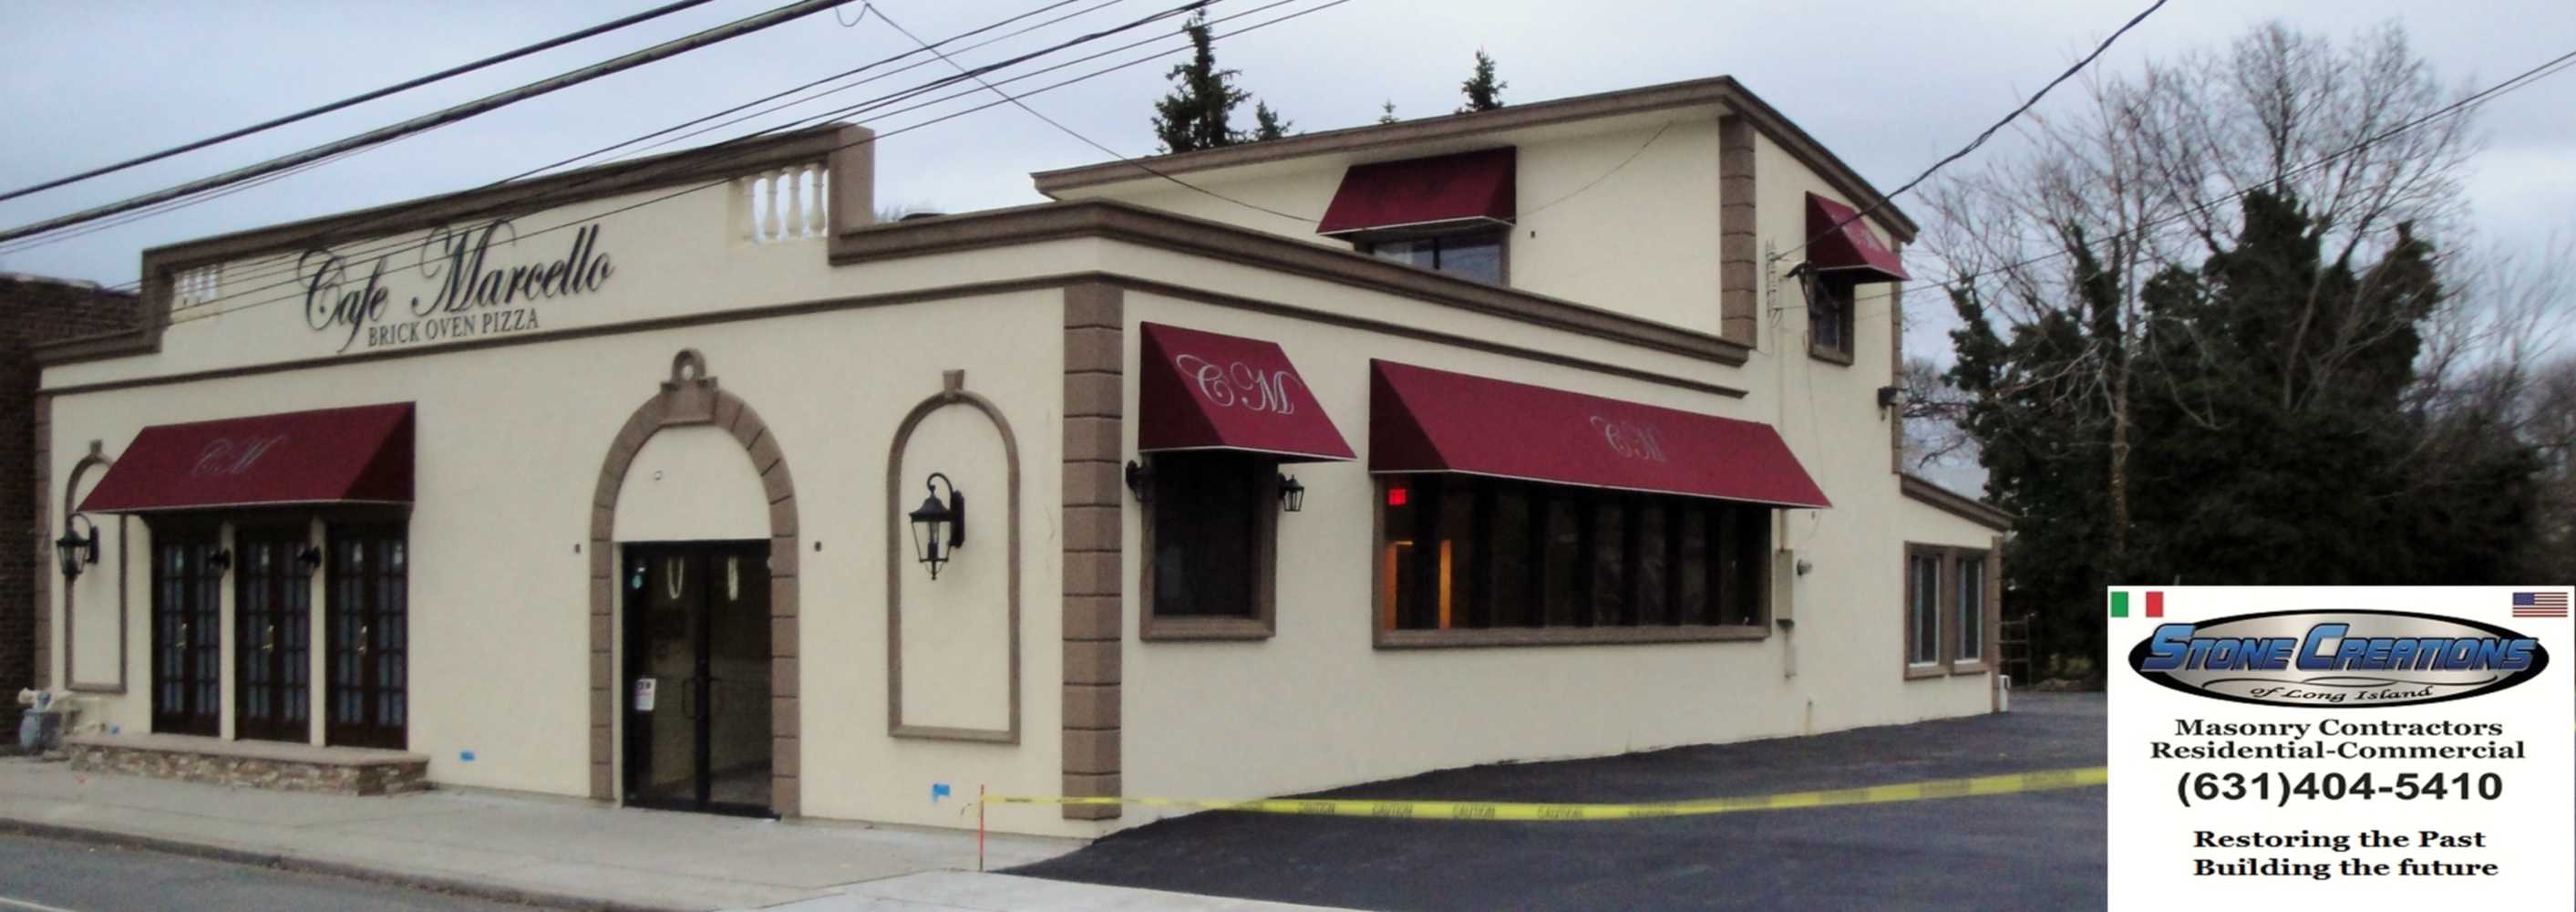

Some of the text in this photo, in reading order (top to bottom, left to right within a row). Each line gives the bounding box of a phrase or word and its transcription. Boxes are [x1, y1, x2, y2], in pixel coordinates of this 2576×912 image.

[297, 217, 615, 355] Cafe Marcello
[366, 307, 540, 348] BRICK OVEN PIZZA
